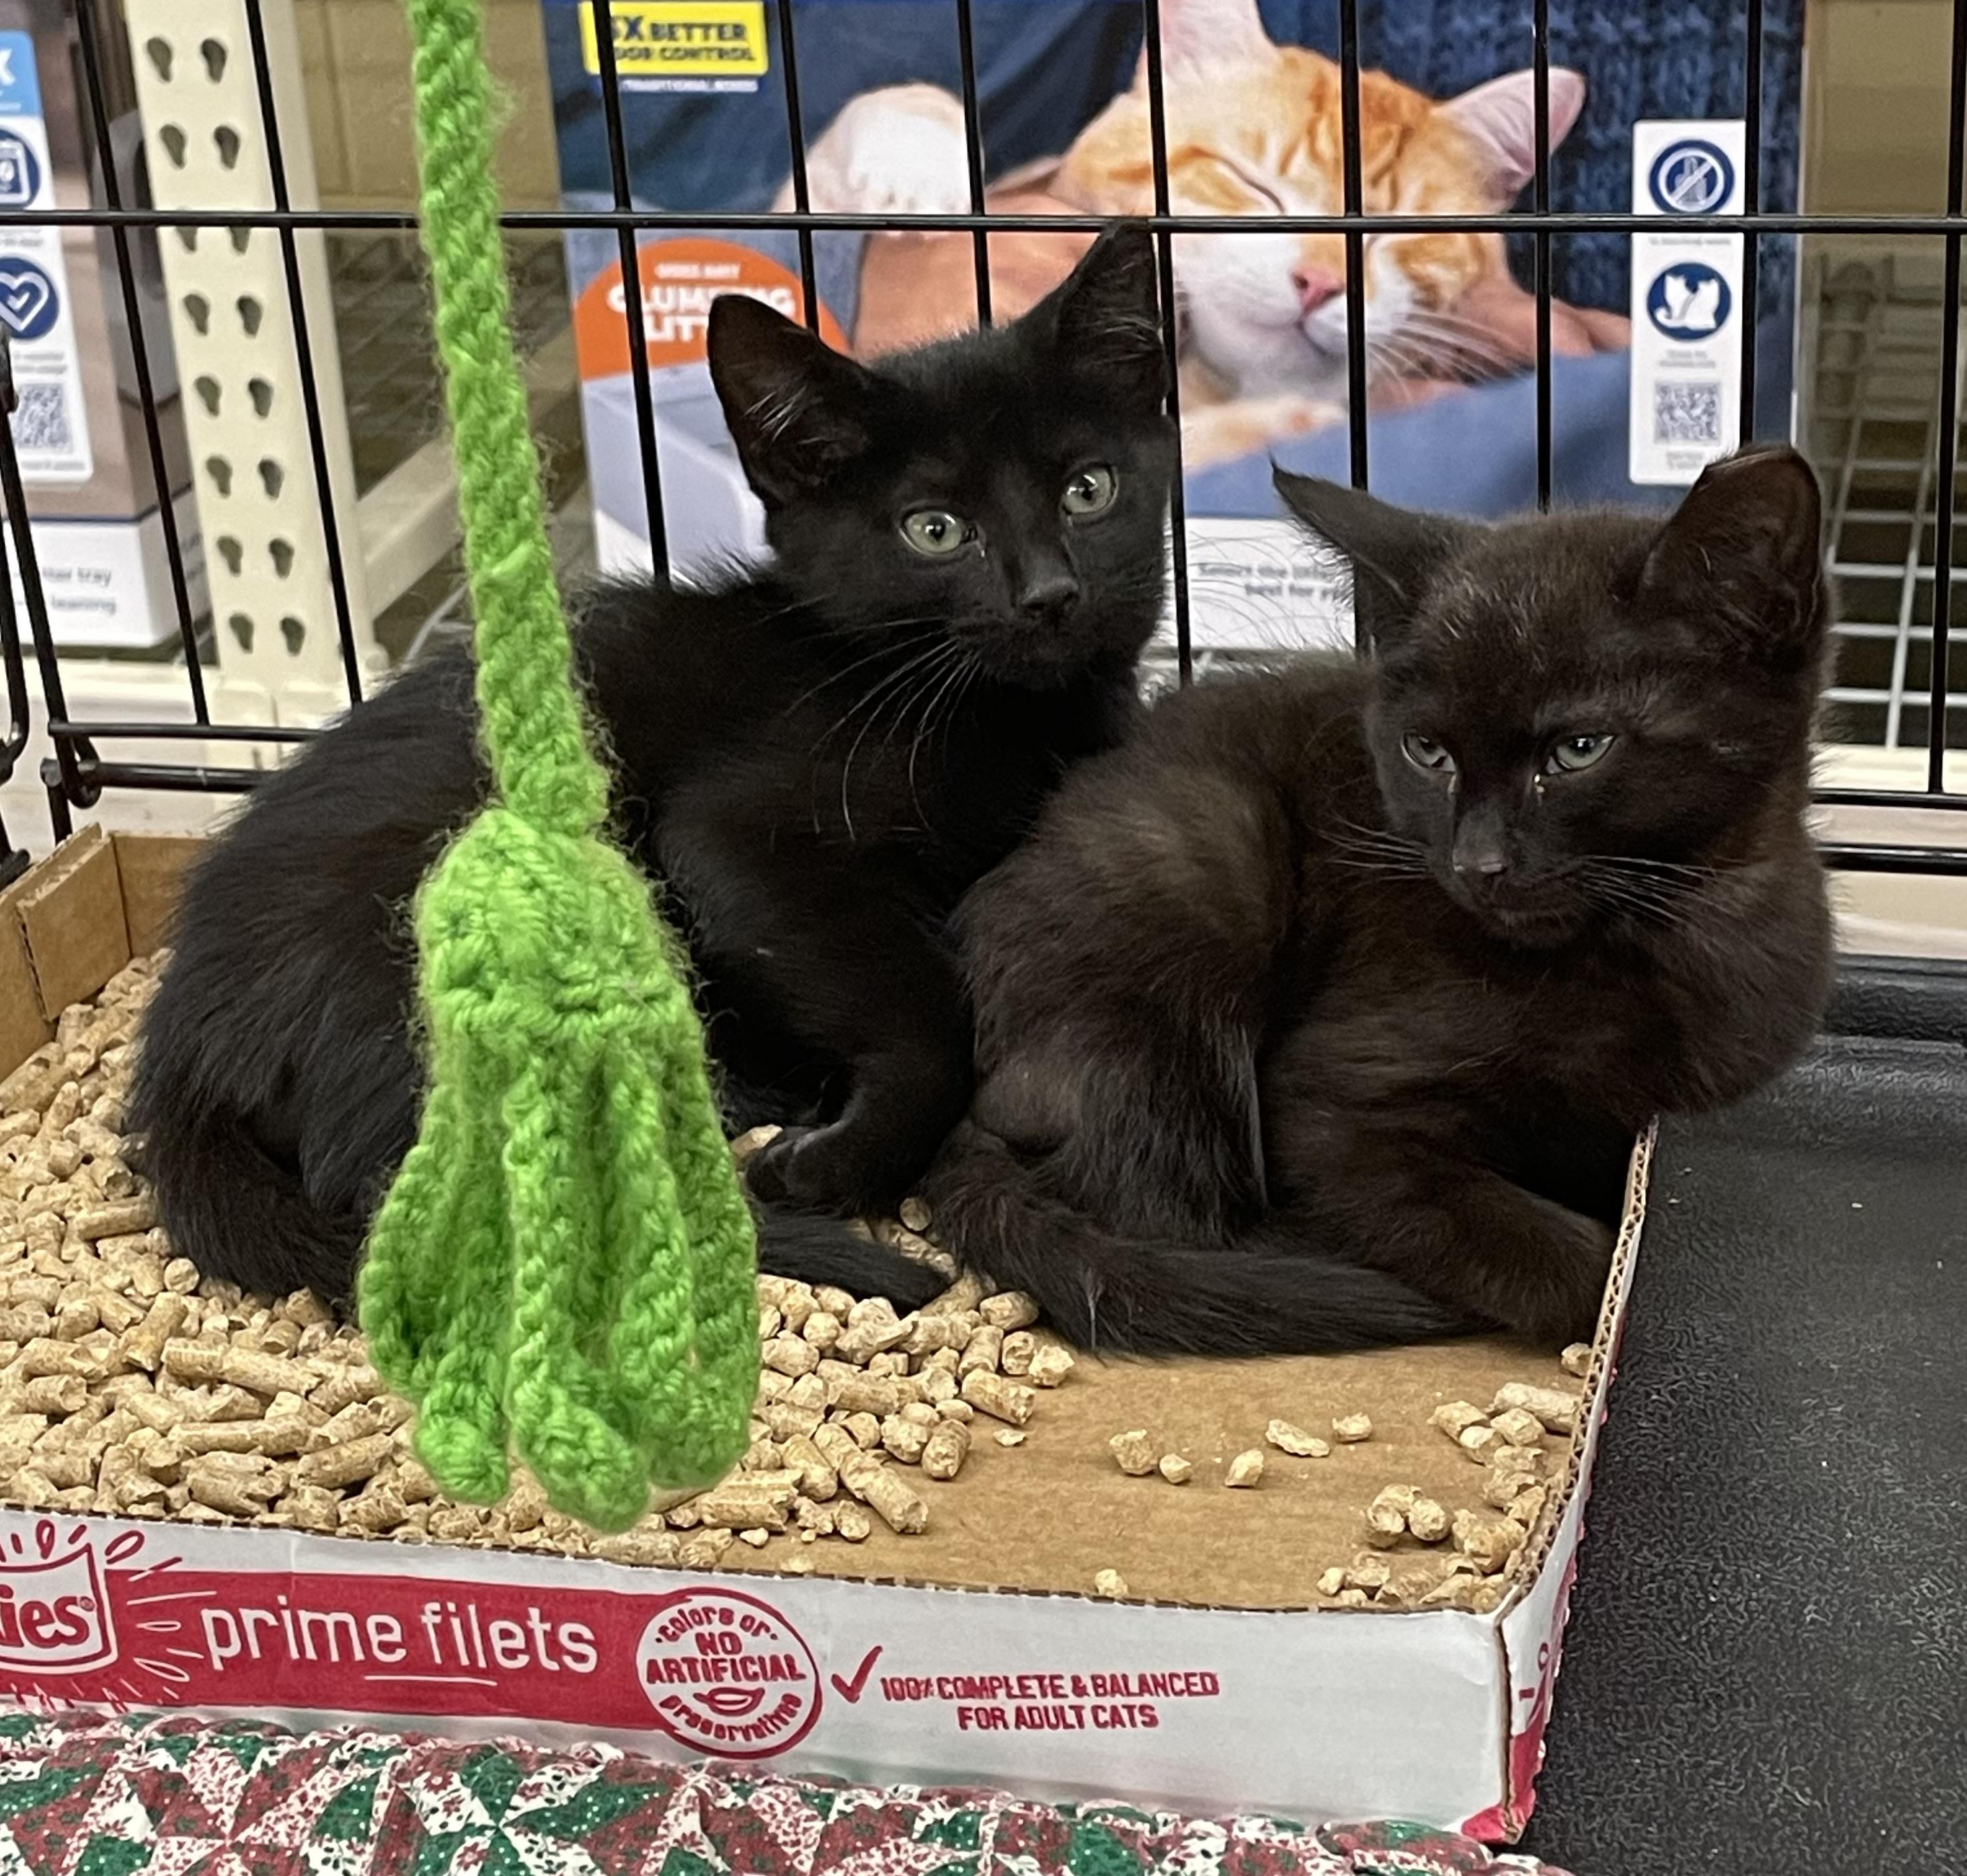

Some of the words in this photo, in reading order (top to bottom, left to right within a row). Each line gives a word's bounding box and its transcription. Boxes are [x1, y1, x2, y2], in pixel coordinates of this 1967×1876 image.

[650, 22, 747, 41] BETTER
[659, 47, 756, 61] CONTROL
[201, 1595, 407, 1671] prime
[420, 1601, 598, 1673] filets
[658, 1606, 735, 1642] colors
[740, 1614, 771, 1637] or
[695, 1631, 742, 1656] NO
[646, 1653, 807, 1684] ARTIFICIAL
[880, 1677, 934, 1701] 100%
[936, 1674, 1069, 1700] COMPLETE
[1070, 1674, 1090, 1698] &
[1090, 1672, 1220, 1697] BALANCED
[957, 1706, 1009, 1730] FOR
[1015, 1705, 1085, 1731] ADULT
[1091, 1704, 1159, 1729] CATS
